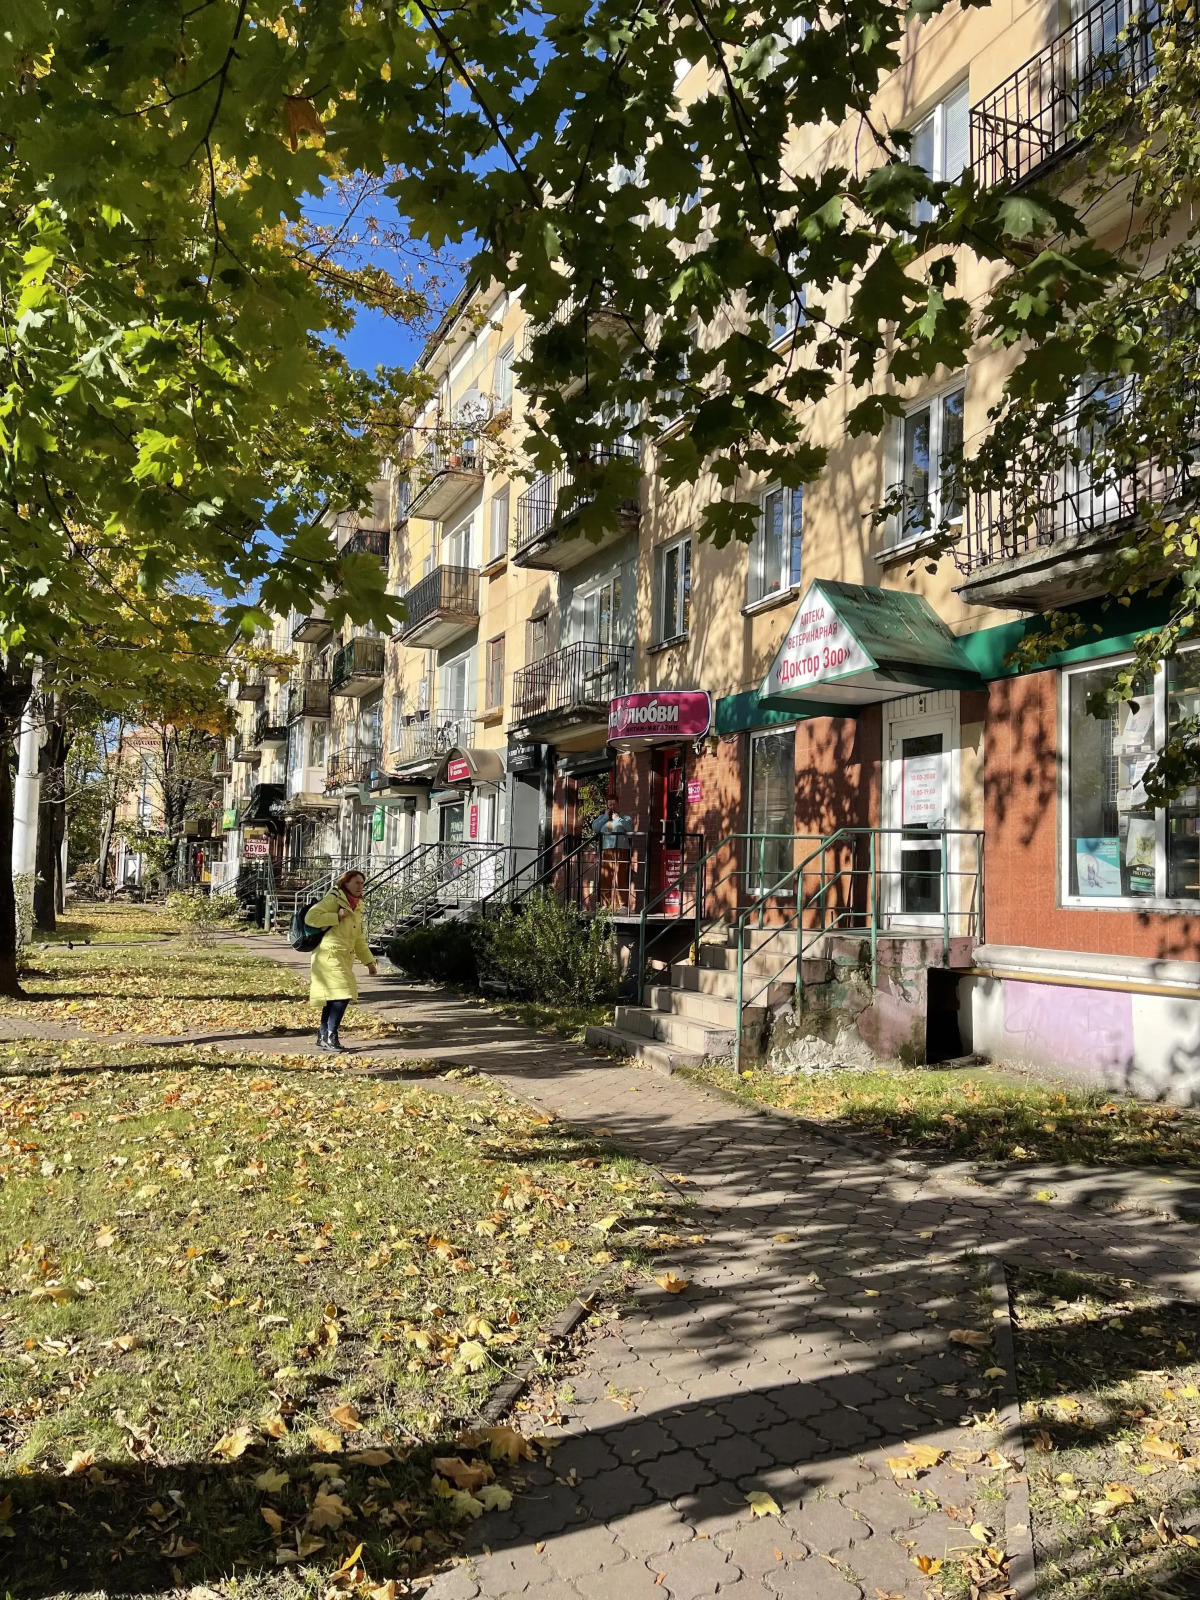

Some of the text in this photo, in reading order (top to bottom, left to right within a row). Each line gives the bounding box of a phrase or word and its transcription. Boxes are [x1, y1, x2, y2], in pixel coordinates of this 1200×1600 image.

[800, 607, 825, 626] АПТЕКА
[787, 621, 838, 650] ВЕТЕРИНАРНАЯ
[776, 646, 851, 684] «Доктор Зоо»
[627, 700, 678, 723] любви
[244, 844, 267, 853] ОБУВЬ
